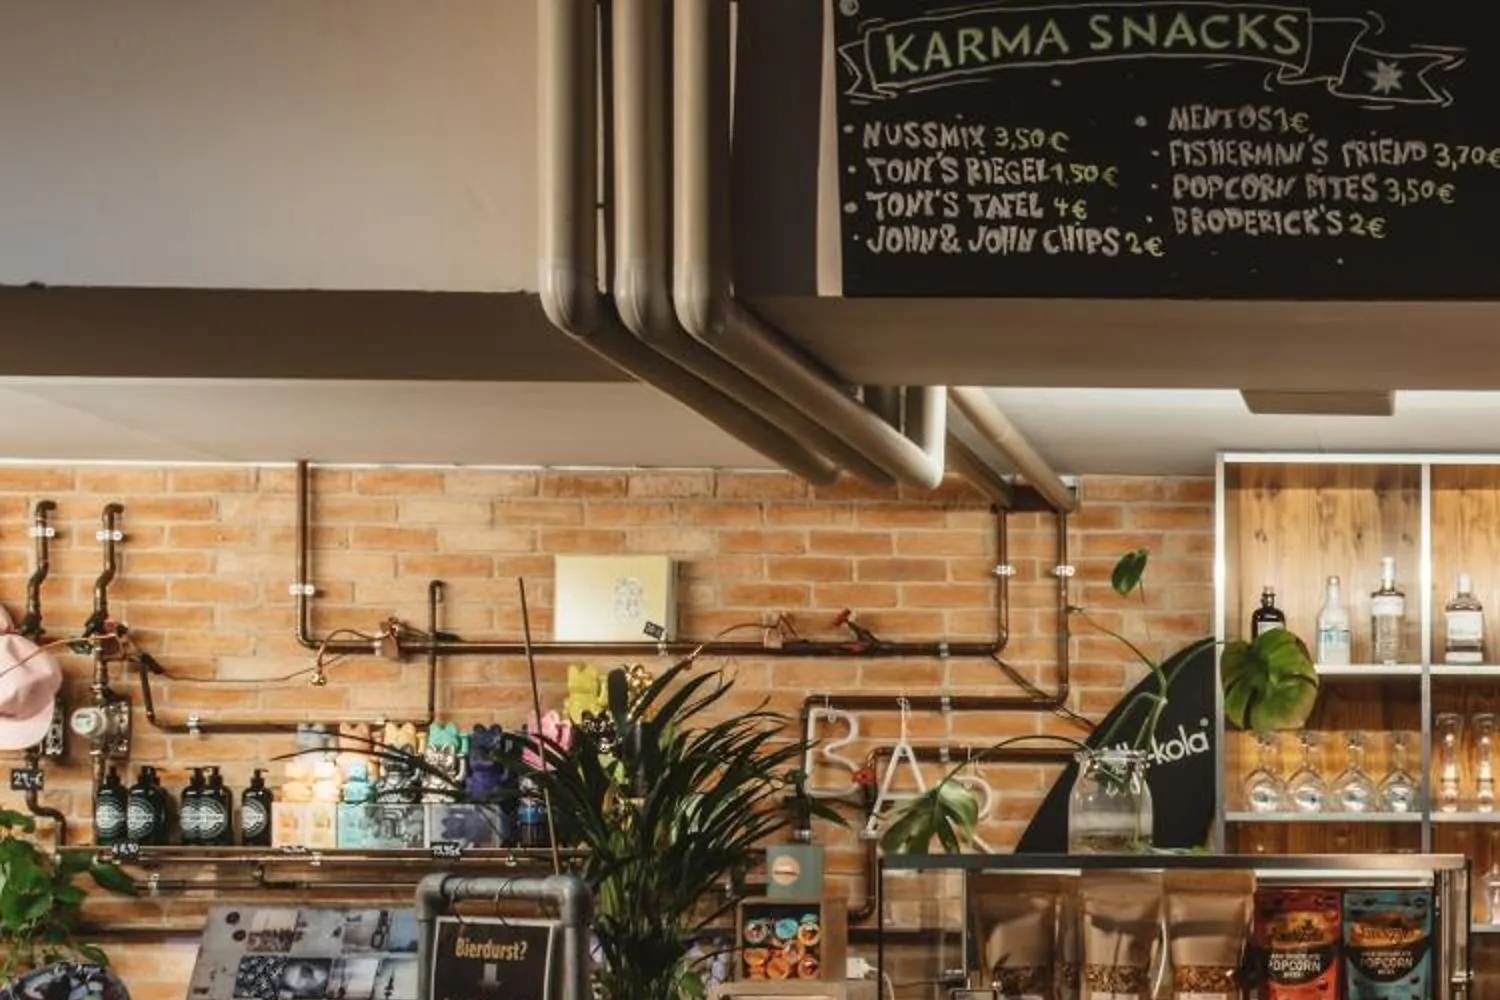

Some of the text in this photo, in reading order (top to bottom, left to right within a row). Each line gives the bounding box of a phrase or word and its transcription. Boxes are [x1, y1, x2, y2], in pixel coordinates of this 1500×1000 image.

[884, 13, 1302, 75] KARMA SNACKS
[863, 113, 986, 150] NUSSMIX
[1167, 104, 1273, 132] MENTOS
[1168, 134, 1330, 168] FISHERMAN'S
[1341, 130, 1428, 168] FRIEND
[865, 152, 960, 185] TONY'S
[966, 150, 1050, 188] RIEGEL
[865, 190, 960, 221] TONY'S
[965, 191, 1045, 221] TAFEL
[1172, 168, 1456, 207] POPCORN BITES 3,50€
[967, 225, 1038, 256] JOHN
[1042, 221, 1122, 257] CHIPS
[1125, 231, 1165, 257] 2€
[1171, 203, 1388, 239] BRODERICK'S 2€
[455, 938, 529, 961] Bierdurst?
